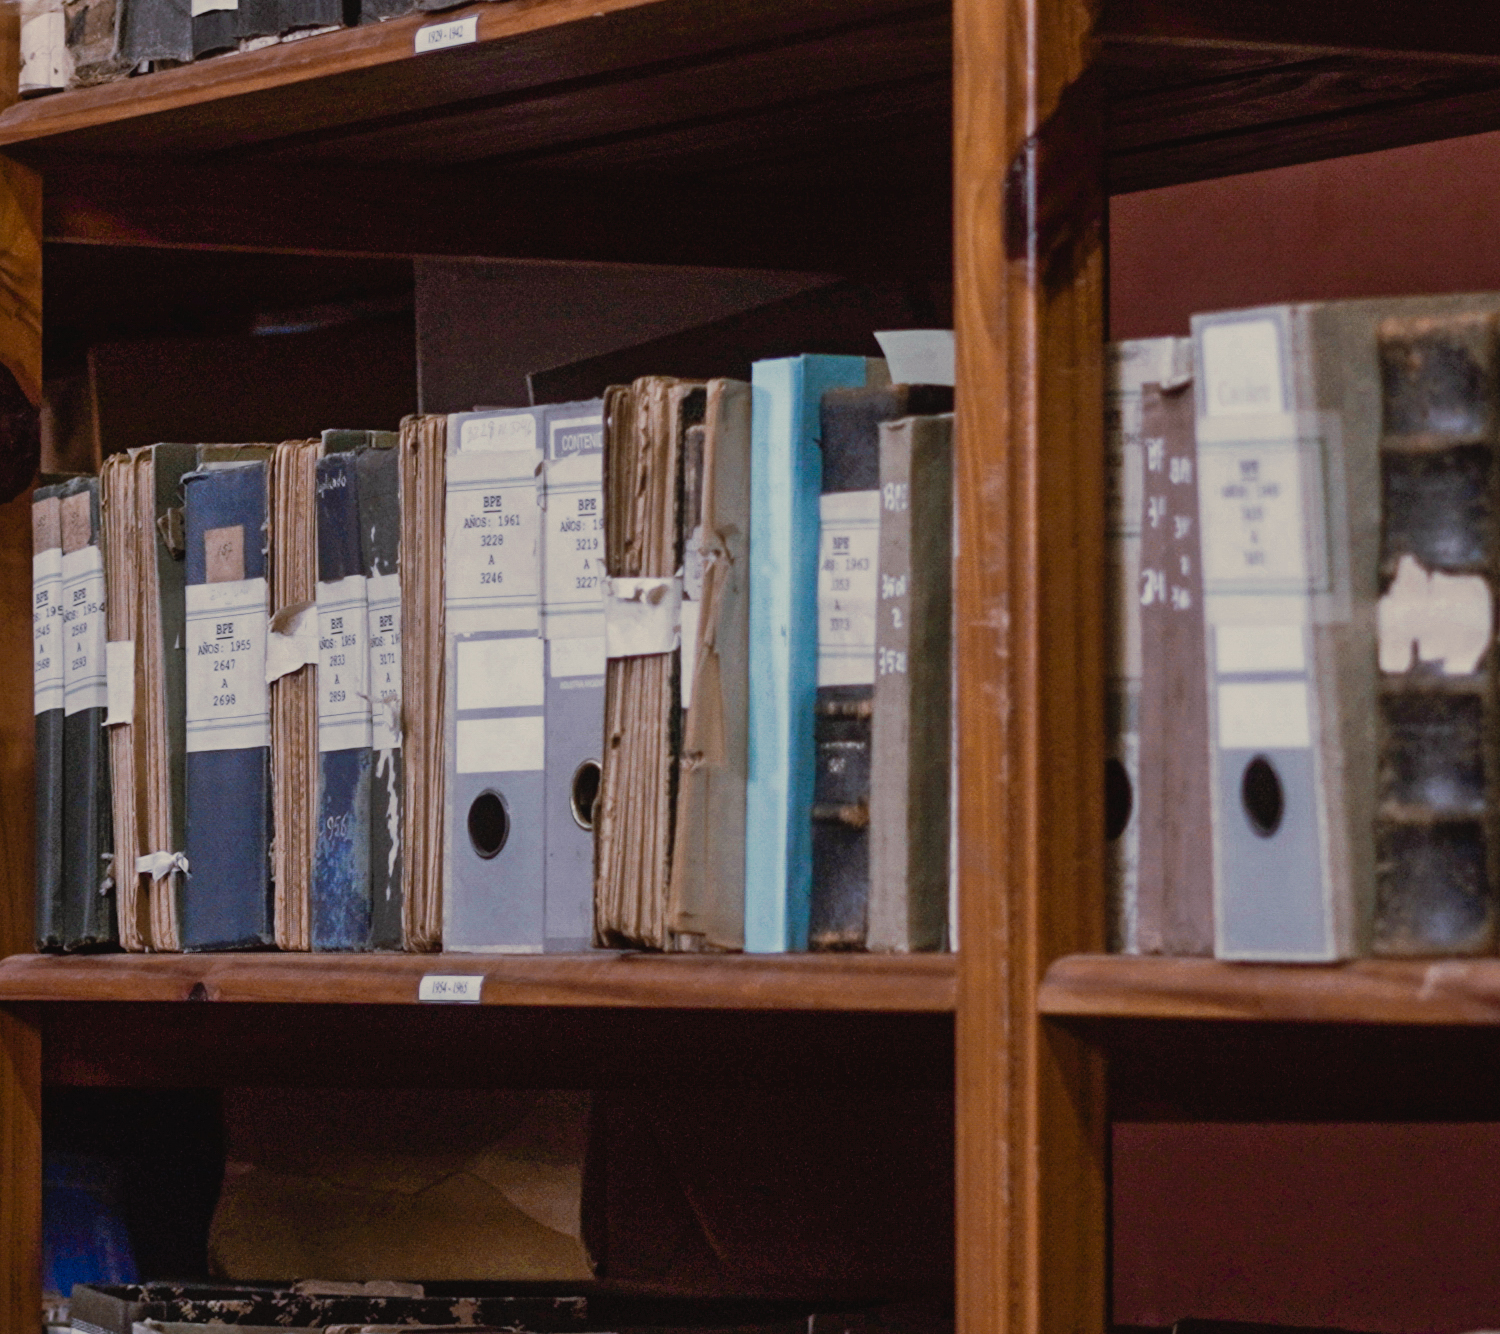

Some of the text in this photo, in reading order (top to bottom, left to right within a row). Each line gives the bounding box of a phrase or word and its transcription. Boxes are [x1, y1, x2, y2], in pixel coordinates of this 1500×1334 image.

[483, 495, 502, 508] BPE
[578, 498, 596, 511] BPE
[463, 514, 520, 529] AÑOS: 1961
[560, 518, 586, 532] AÑOS:
[480, 534, 504, 547] 3228
[576, 538, 598, 551] 3219
[488, 554, 495, 565] A
[583, 559, 590, 569] A
[480, 572, 503, 584] 3246
[576, 576, 598, 589] 3227
[73, 588, 87, 602] BPE
[83, 602, 105, 618] 1954
[330, 617, 343, 630] BPE
[379, 615, 393, 627] BPE
[216, 623, 234, 635] BPE
[197, 639, 251, 656] AÑOS: 1955
[213, 659, 236, 671] 2647
[329, 654, 346, 667] 2833
[380, 653, 395, 666] 3171
[221, 678, 228, 688] A
[213, 694, 236, 706] 2698
